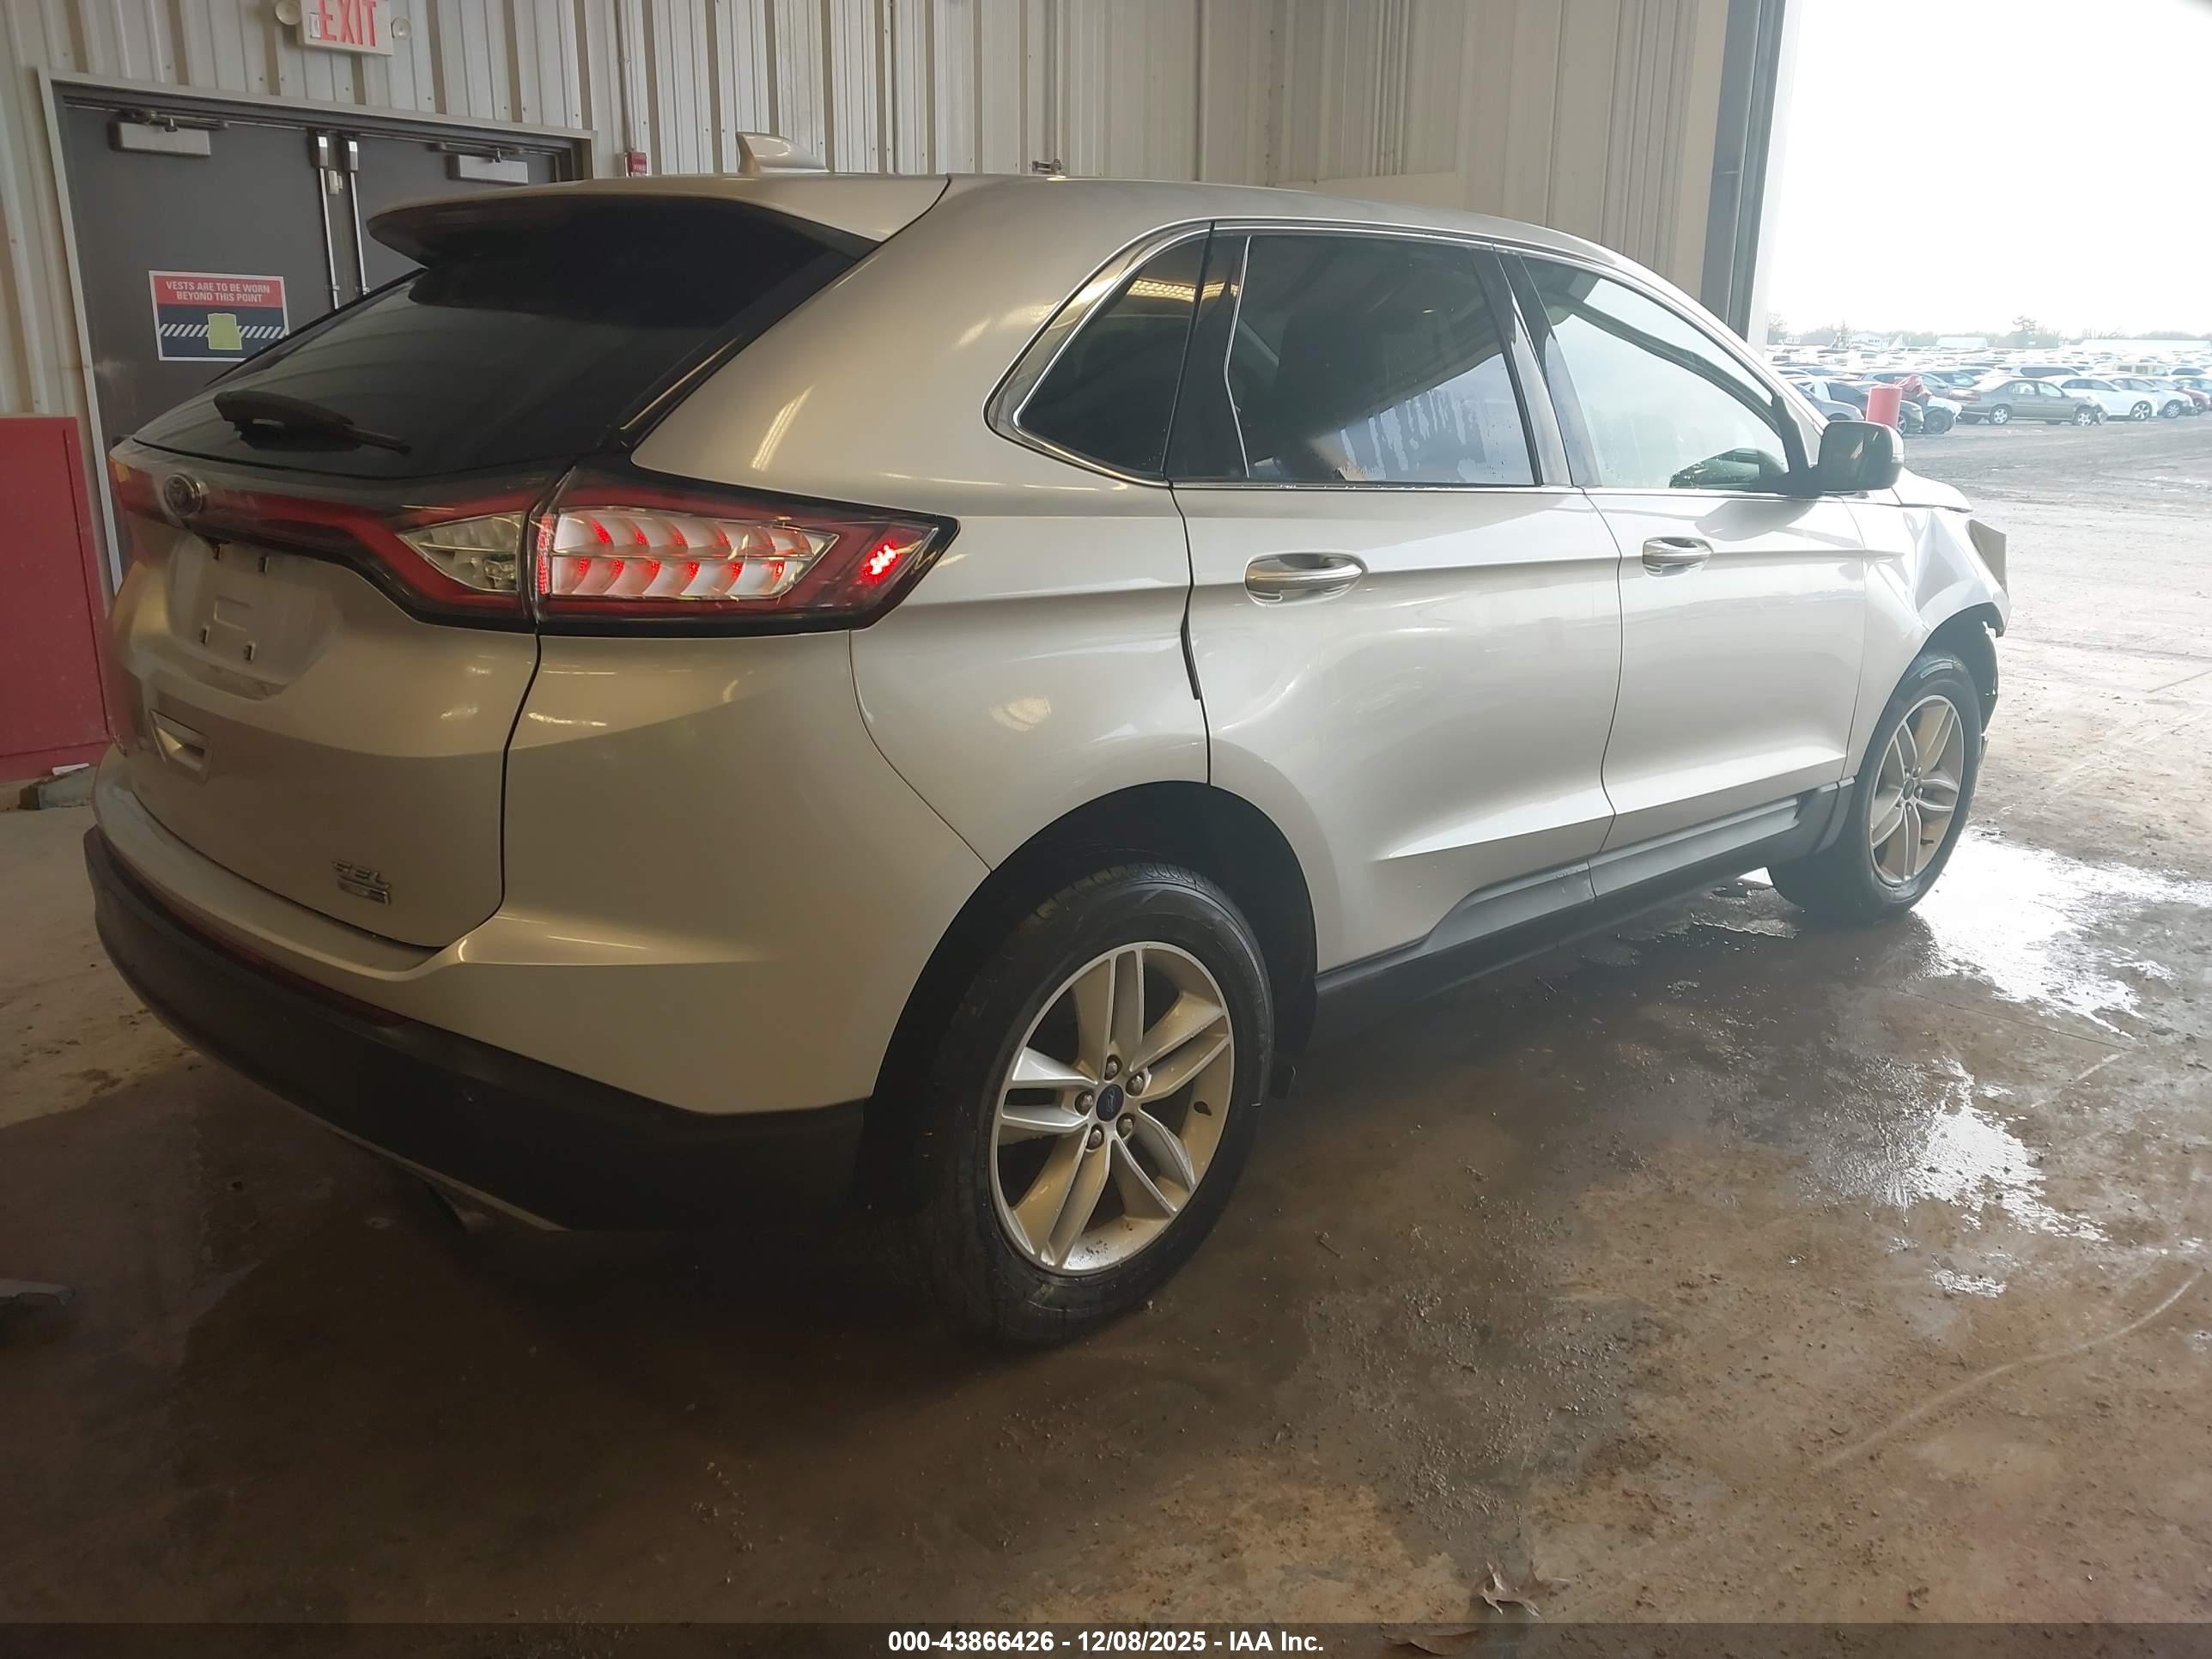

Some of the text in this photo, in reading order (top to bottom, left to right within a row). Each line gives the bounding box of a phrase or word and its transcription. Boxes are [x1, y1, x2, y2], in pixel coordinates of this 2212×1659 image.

[319, 0, 376, 47] EXIT
[166, 281, 270, 294] VESTS ARE TO BE WORN
[176, 291, 263, 303] BEYOND THIS POINT
